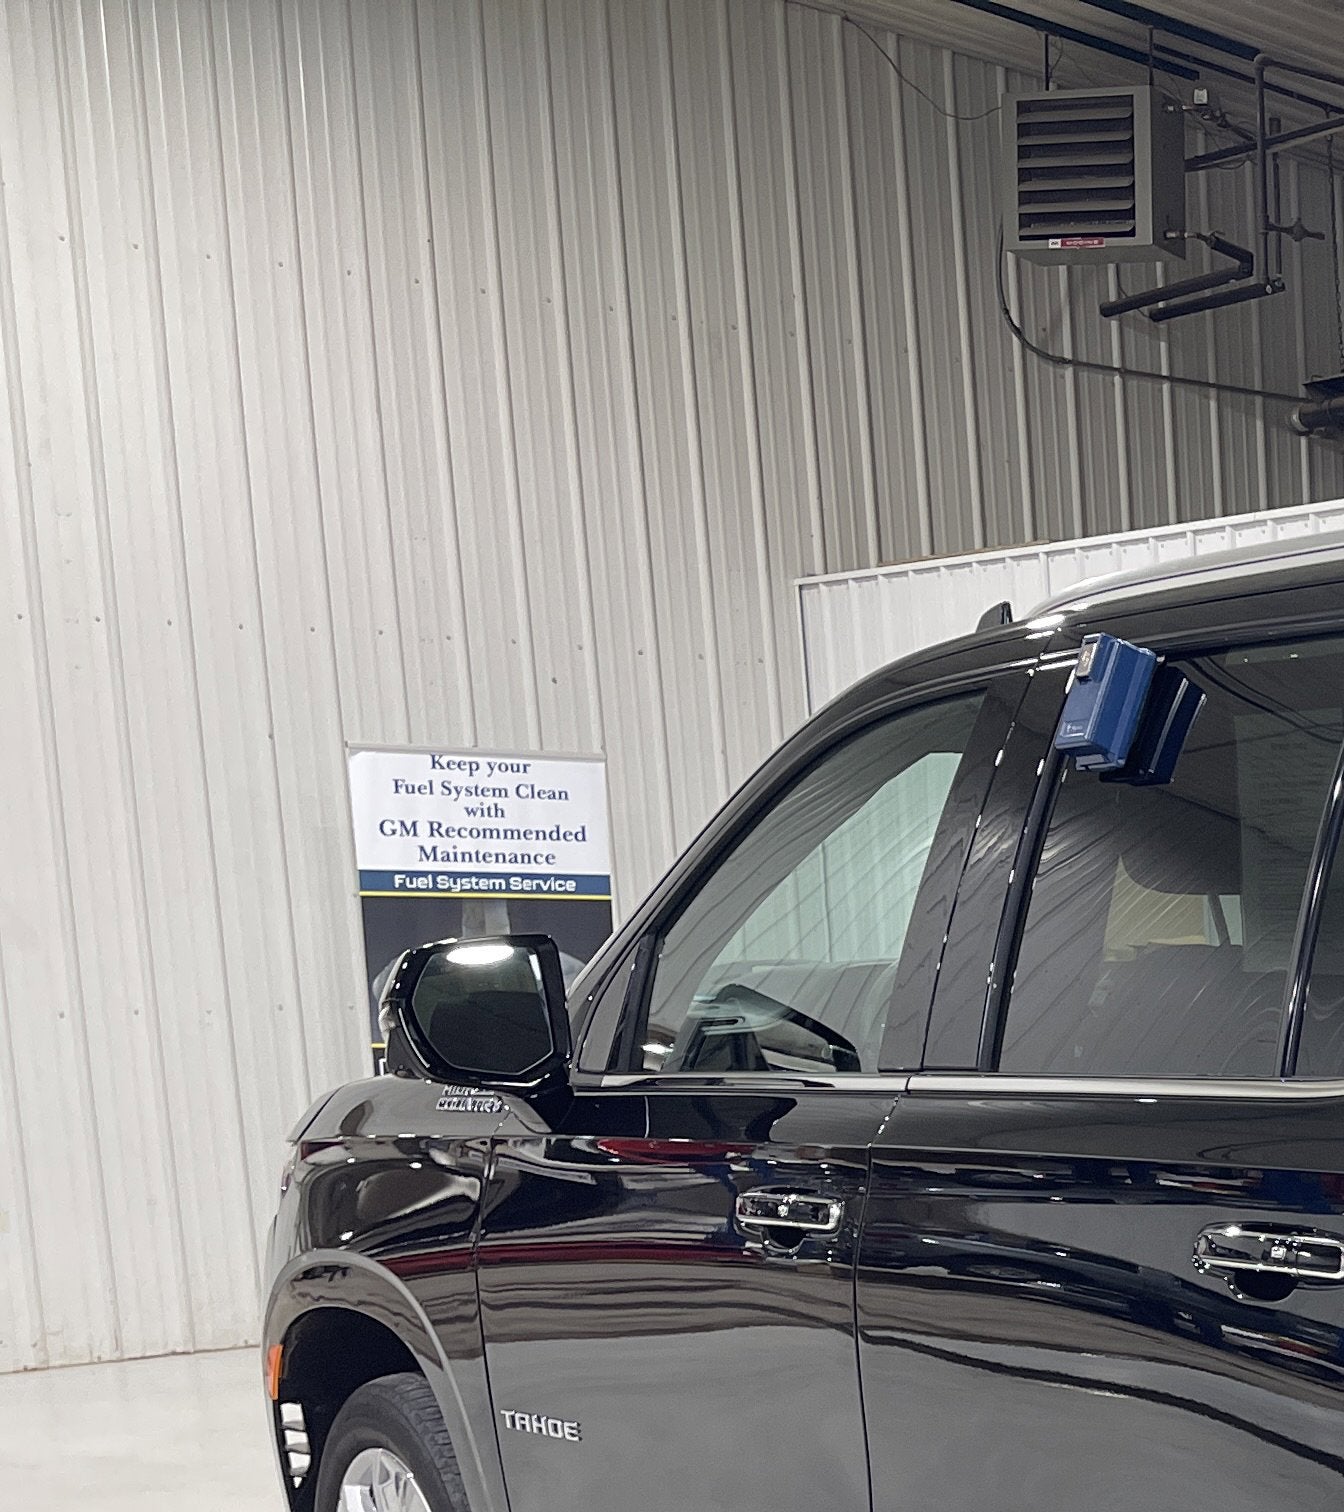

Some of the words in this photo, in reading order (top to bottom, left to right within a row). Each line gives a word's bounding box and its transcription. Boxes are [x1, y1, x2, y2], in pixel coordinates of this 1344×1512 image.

[430, 754, 480, 777] Keep
[486, 761, 532, 777] your
[392, 778, 435, 796] Fuel
[440, 781, 509, 803] System
[515, 783, 570, 801] Clean
[464, 802, 506, 819] with
[379, 820, 420, 838] GM
[428, 821, 588, 844] Recommended
[418, 846, 557, 866] Maintenance
[393, 874, 434, 889] Fuel
[436, 876, 506, 892] System
[509, 876, 577, 893] Service
[500, 1409, 580, 1442] TAHOE
